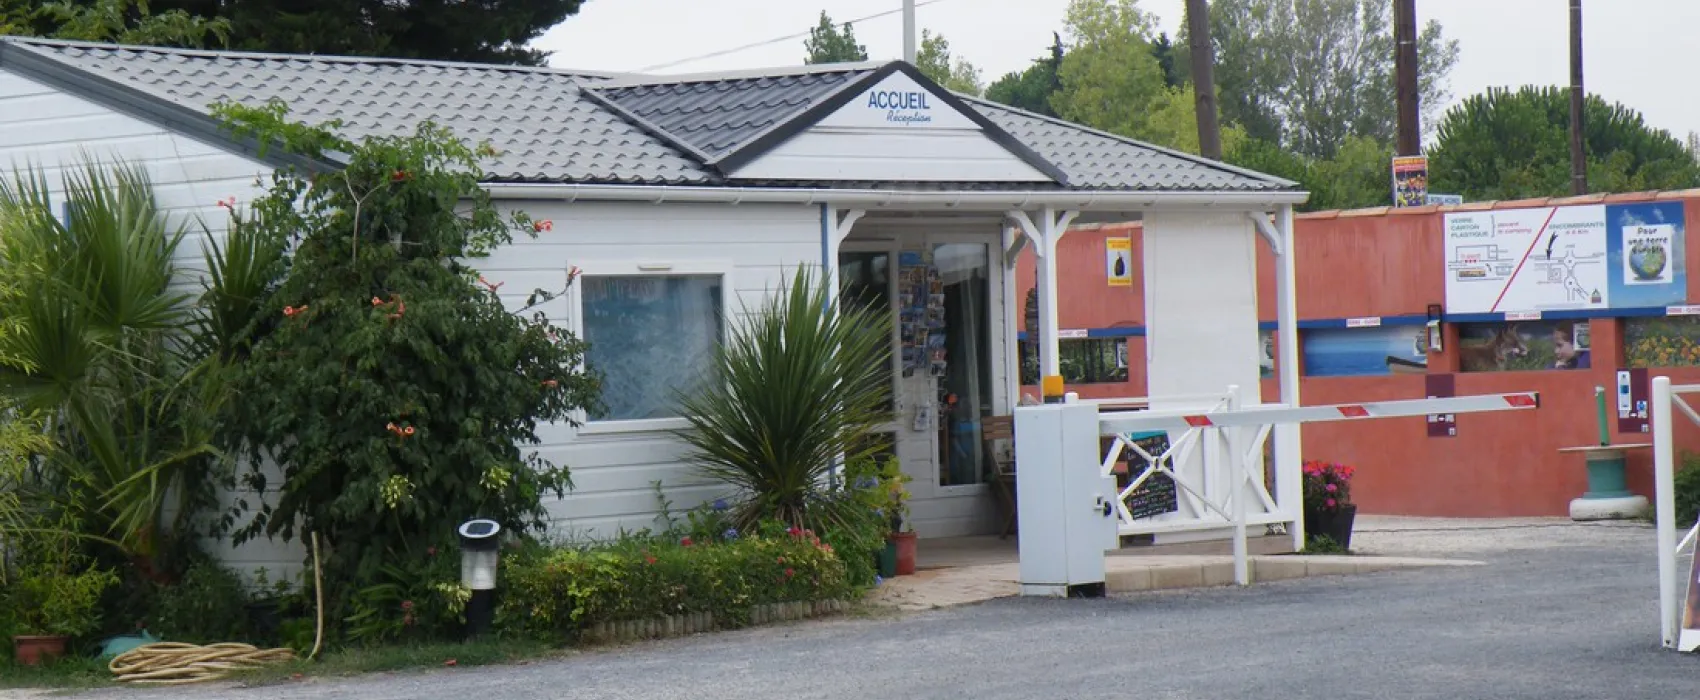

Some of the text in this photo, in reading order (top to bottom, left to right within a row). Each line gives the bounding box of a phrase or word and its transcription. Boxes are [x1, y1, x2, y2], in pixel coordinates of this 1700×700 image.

[868, 91, 930, 110] ACCUEIL
[886, 110, 931, 126] Réception
[1549, 221, 1604, 229] ENCOMBRANTS
[1637, 227, 1657, 235] Pour
